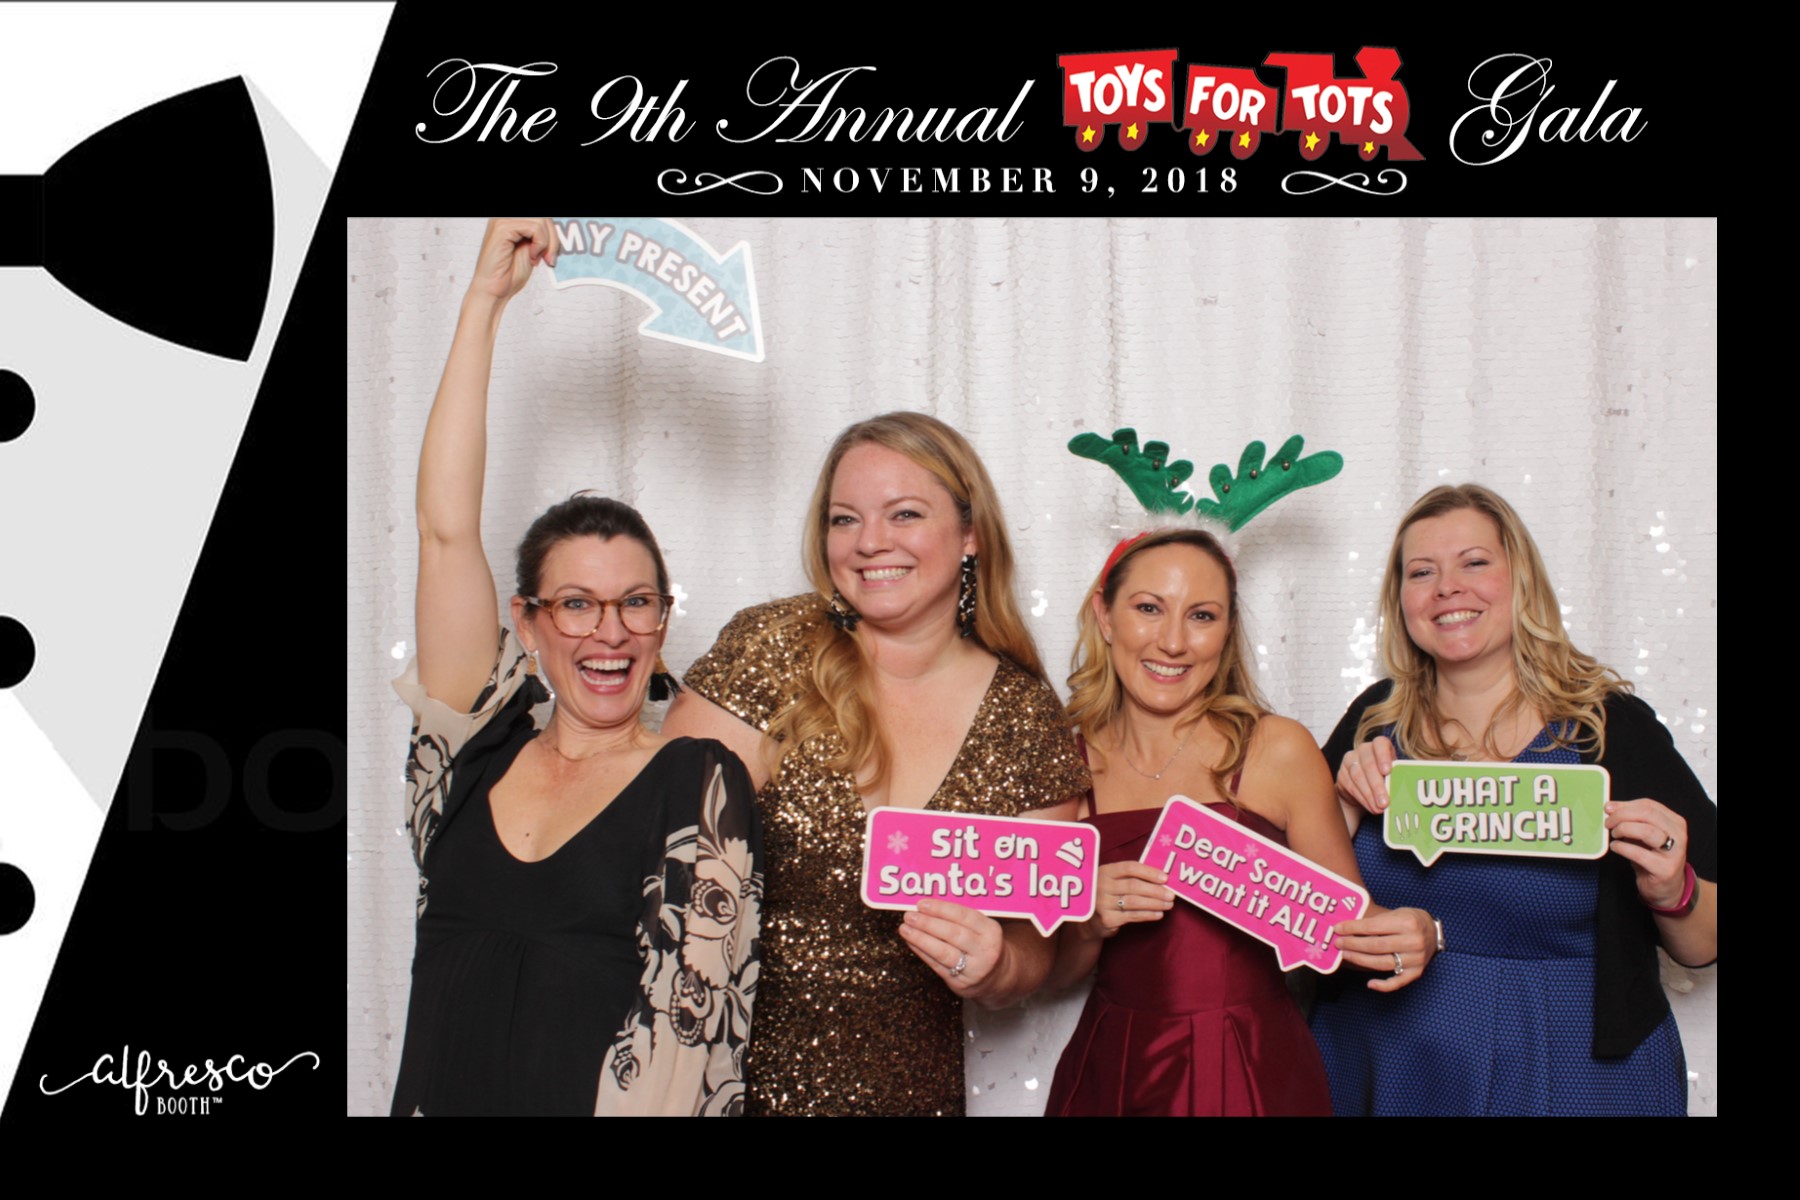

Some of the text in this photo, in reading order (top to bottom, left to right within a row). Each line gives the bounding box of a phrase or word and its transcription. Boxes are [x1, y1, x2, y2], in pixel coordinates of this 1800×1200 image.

[555, 220, 748, 340] MY PRESENT
[1417, 775, 1557, 807] WHAT A
[930, 825, 980, 859] Sit
[1430, 807, 1573, 844] GRINCH!
[878, 863, 1083, 909] Santa's lap
[1162, 851, 1177, 874] I
[1179, 861, 1247, 908] want
[1246, 890, 1271, 919] it
[1174, 823, 1338, 915] Dear Santa:
